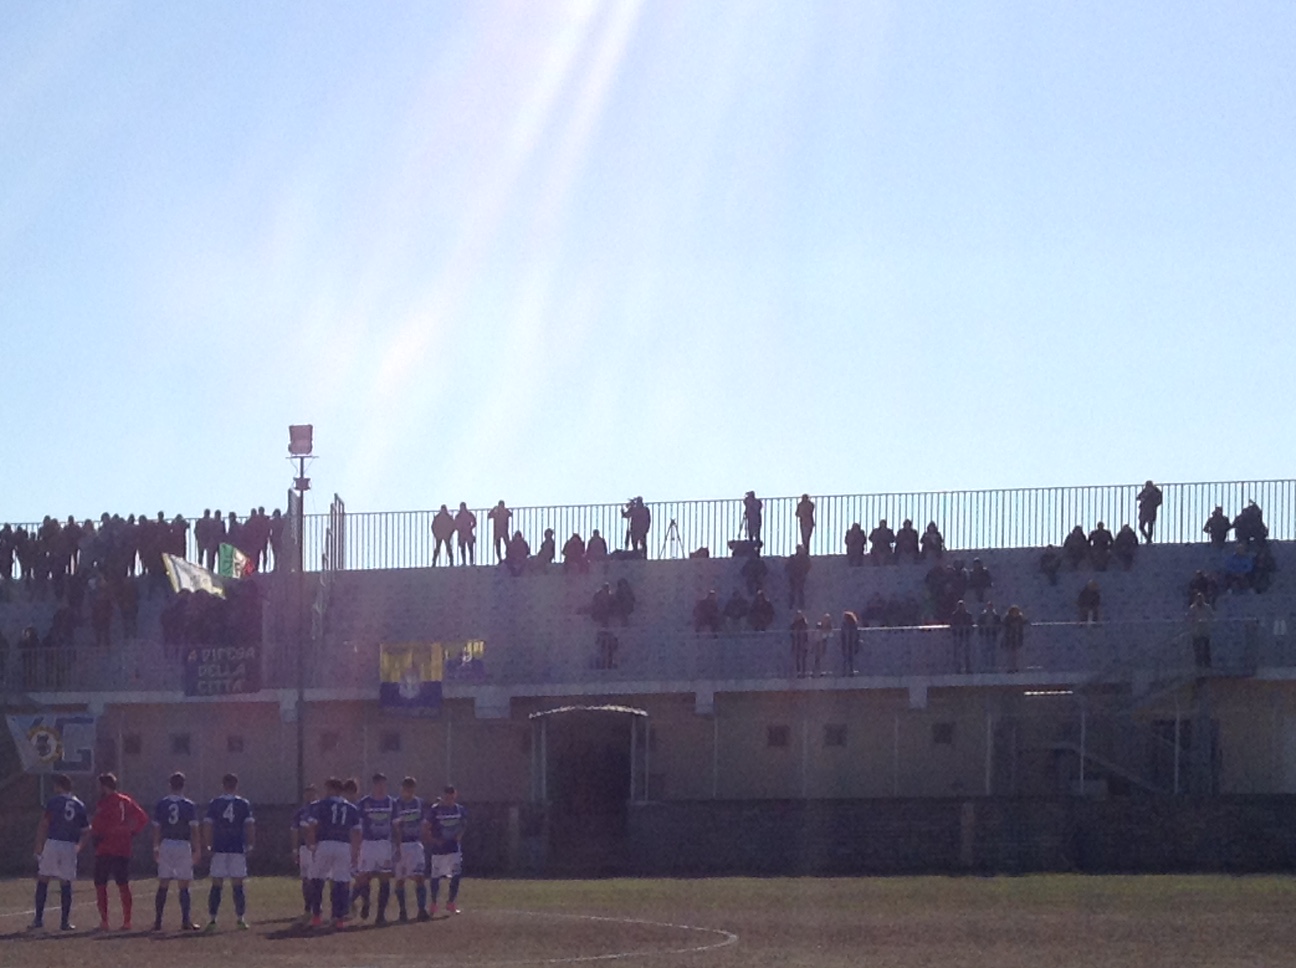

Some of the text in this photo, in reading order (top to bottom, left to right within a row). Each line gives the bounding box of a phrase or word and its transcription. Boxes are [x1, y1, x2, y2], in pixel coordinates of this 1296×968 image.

[64, 800, 75, 821] 5
[118, 801, 125, 821] 1
[168, 803, 179, 824] 3
[222, 803, 235, 823] 4
[330, 803, 347, 825] 11
